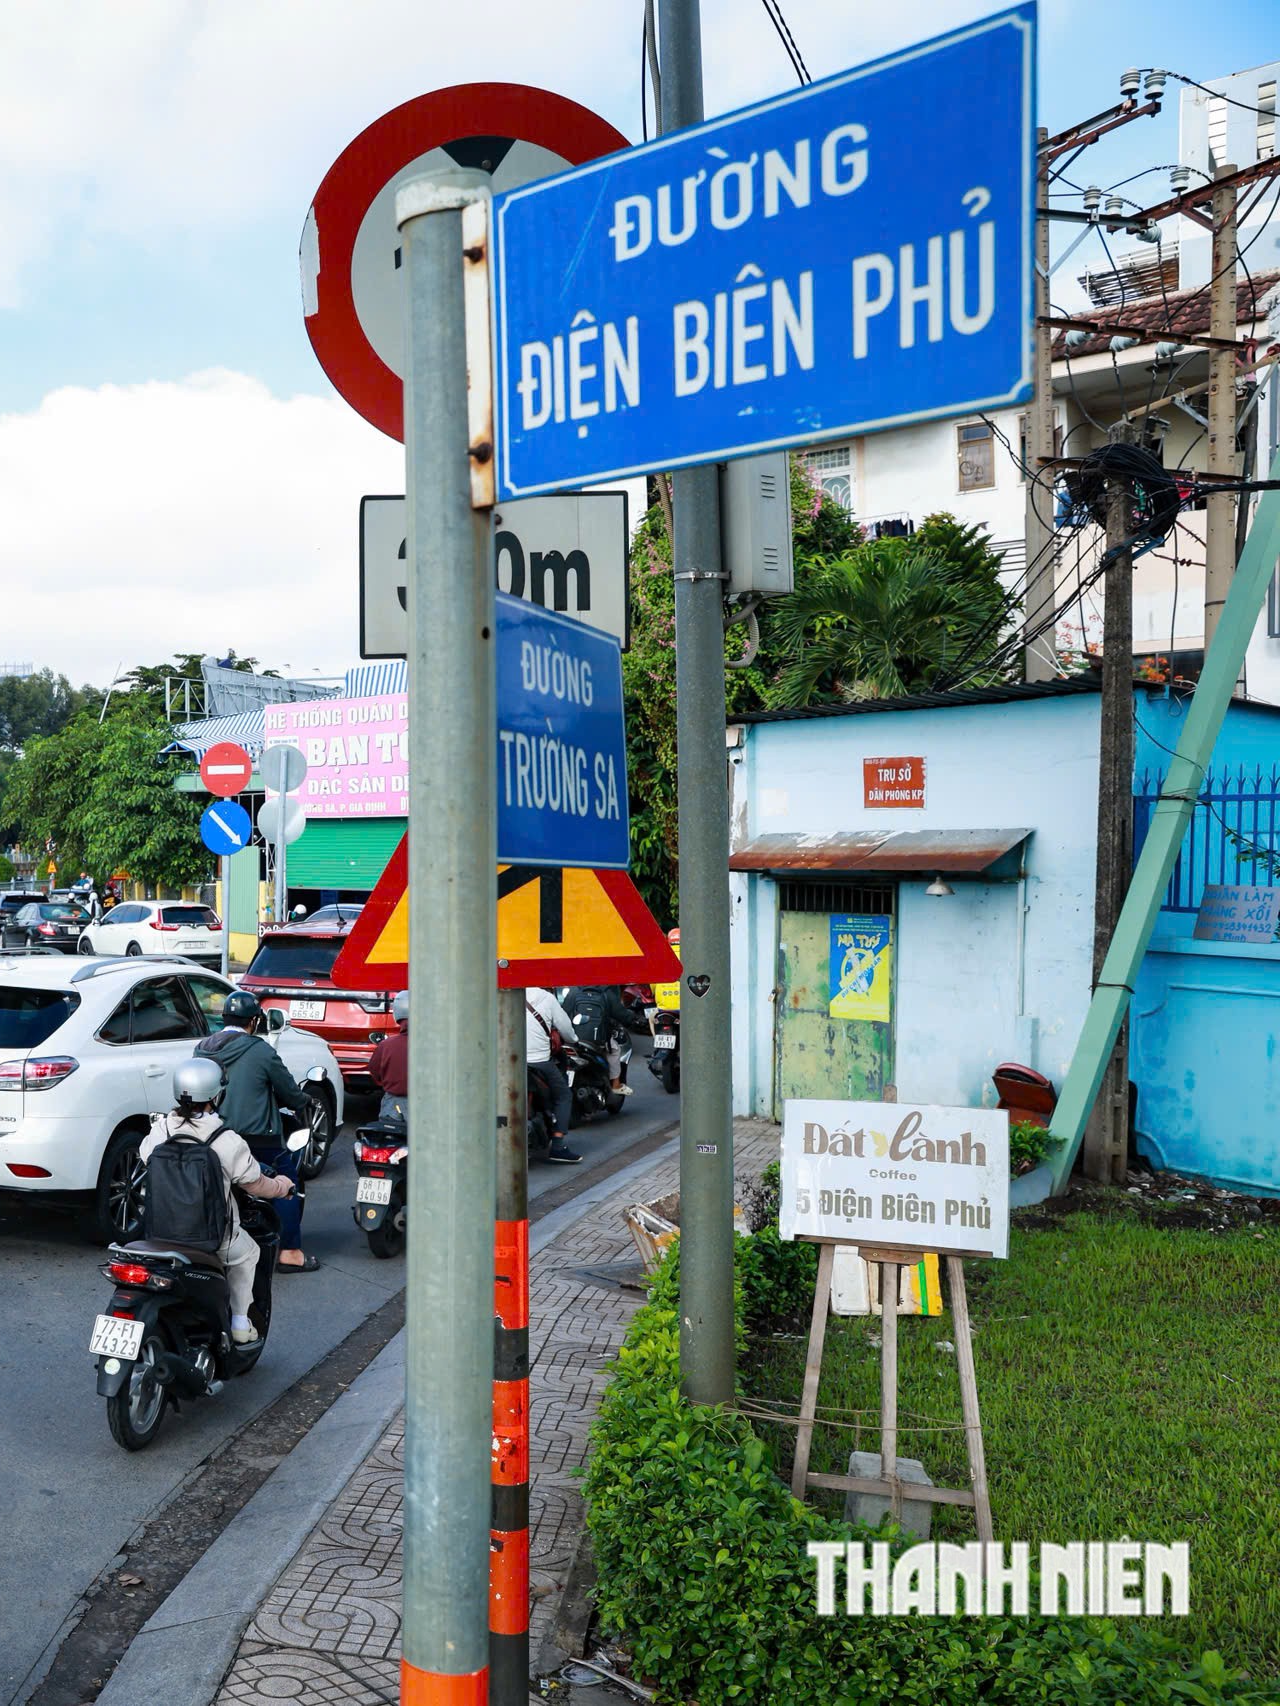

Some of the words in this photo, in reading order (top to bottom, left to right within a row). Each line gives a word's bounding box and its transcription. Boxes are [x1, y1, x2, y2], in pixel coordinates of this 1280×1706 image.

[610, 123, 869, 262] ĐƯỜNG
[517, 309, 641, 439] ĐIỆN
[673, 263, 815, 398] BIÊN
[852, 186, 996, 360] PHỦ
[521, 634, 593, 707] ĐƯỜNG
[268, 710, 286, 732] HỆ
[290, 705, 342, 728] THỐNG
[347, 702, 394, 726] QUÁN
[306, 735, 370, 774] BẠN
[499, 718, 588, 817] TRƯỜNG
[595, 752, 620, 821] SA
[877, 768, 896, 785] TRỤ
[898, 763, 912, 782] SỞ
[308, 775, 342, 799] ĐẶC
[348, 771, 386, 795] SẢN
[803, 1119, 867, 1158] Đất
[869, 1168, 917, 1181] Coffee
[796, 1188, 811, 1215] 5
[818, 1187, 873, 1224] Điện
[881, 1192, 936, 1225] Biên
[944, 1197, 991, 1230] Phủ
[93, 1335, 137, 1357] 743.23
[101, 1318, 135, 1339] 77-F1
